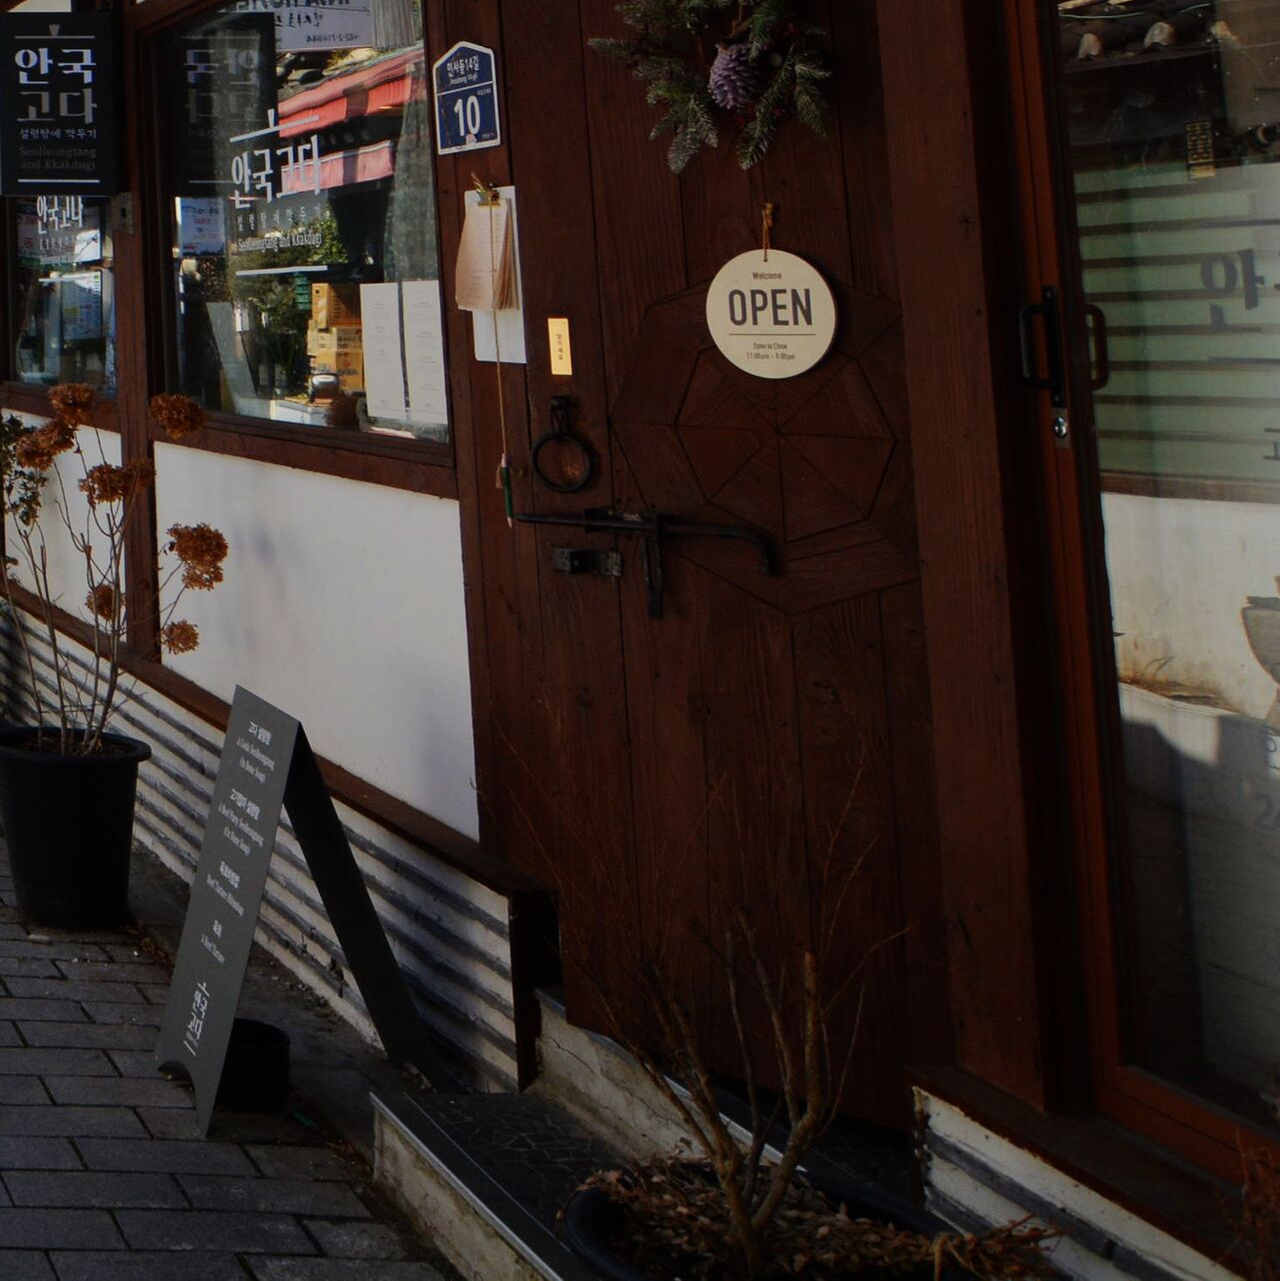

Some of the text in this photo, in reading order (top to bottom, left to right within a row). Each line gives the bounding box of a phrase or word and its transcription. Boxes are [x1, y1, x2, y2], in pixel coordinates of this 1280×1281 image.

[14, 47, 96, 85] 안국
[16, 87, 98, 124] 고다
[454, 95, 481, 136] 10
[231, 134, 321, 210] 안국고다
[752, 272, 782, 280] Welcome
[728, 289, 813, 326] OPEN
